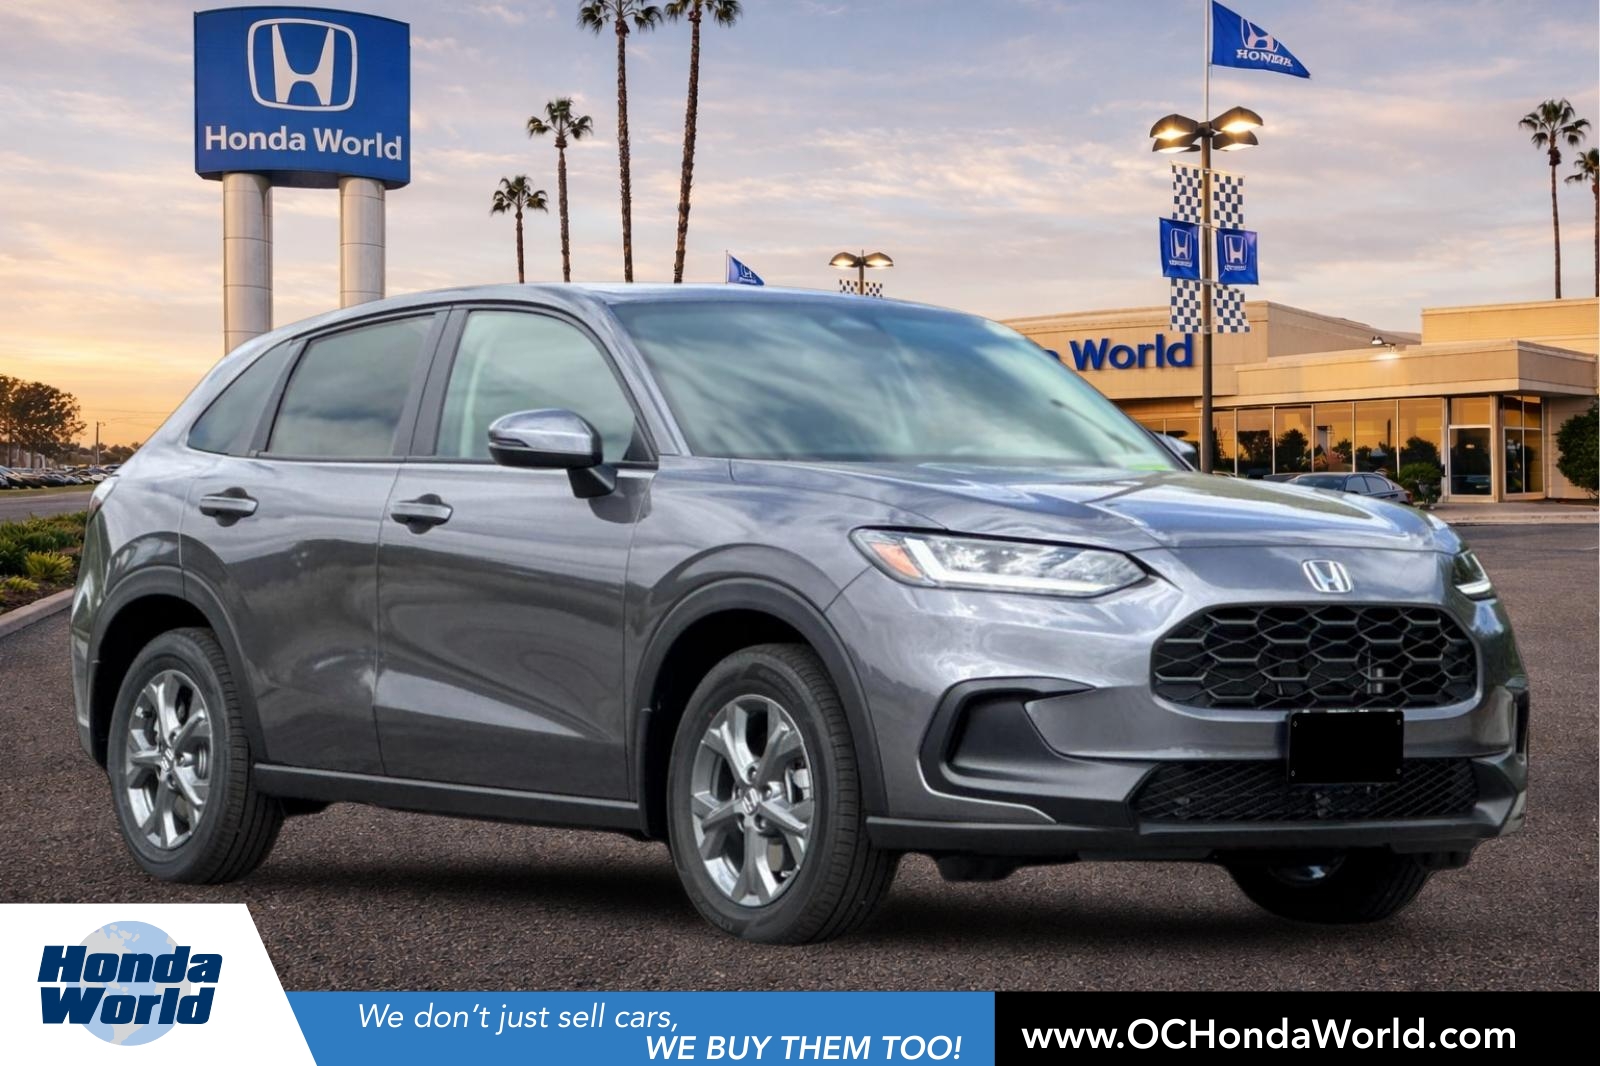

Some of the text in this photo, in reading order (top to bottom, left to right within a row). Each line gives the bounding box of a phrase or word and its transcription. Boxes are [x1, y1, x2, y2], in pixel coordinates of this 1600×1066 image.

[205, 125, 402, 160] Honda World
[1069, 333, 1194, 371] World
